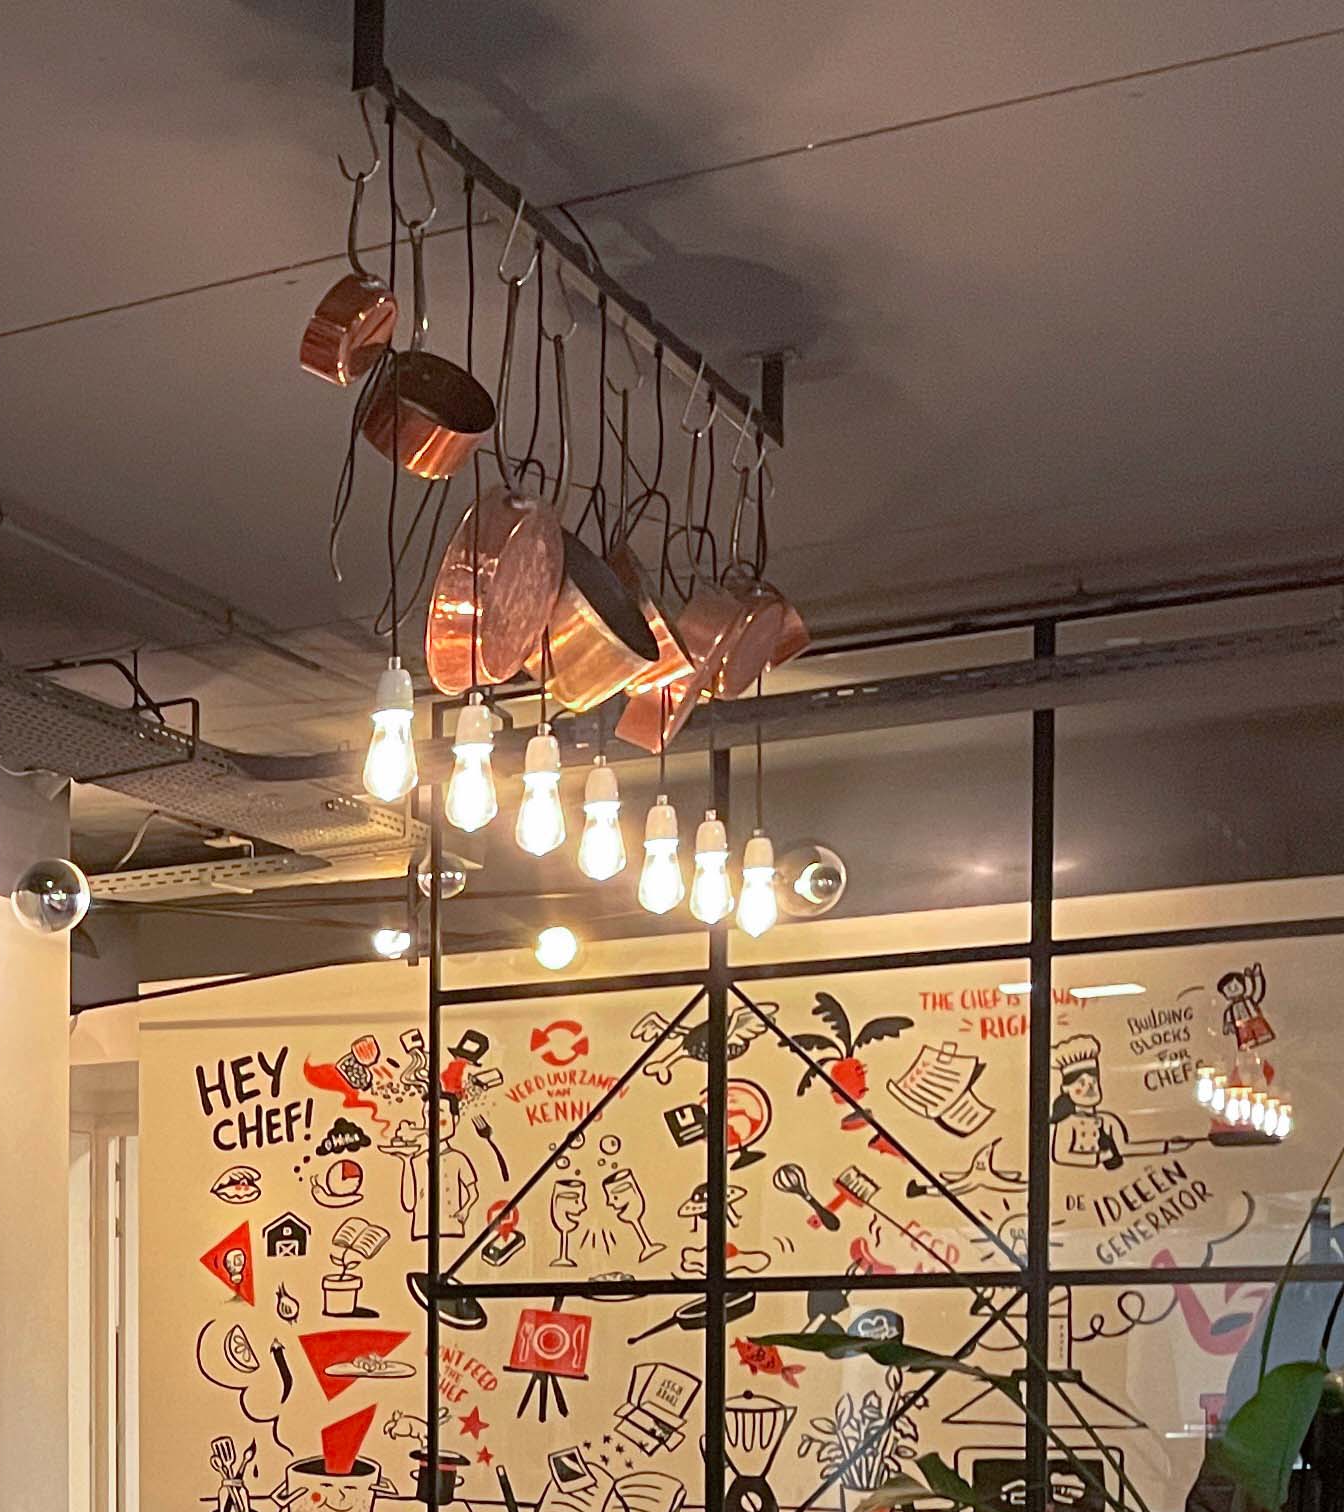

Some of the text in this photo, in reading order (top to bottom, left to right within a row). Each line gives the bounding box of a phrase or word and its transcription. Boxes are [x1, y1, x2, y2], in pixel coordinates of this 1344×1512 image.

[920, 991, 955, 1011] THE
[980, 1016, 1028, 1040] RIG
[1130, 1027, 1192, 1055] BLOCKS
[195, 1046, 289, 1116] HEY
[212, 1098, 313, 1151] CHEF!
[1066, 1194, 1086, 1212] DE
[1096, 1179, 1214, 1266] GENERATOR
[463, 1357, 499, 1392] FEED
[438, 1376, 470, 1403] HEF
